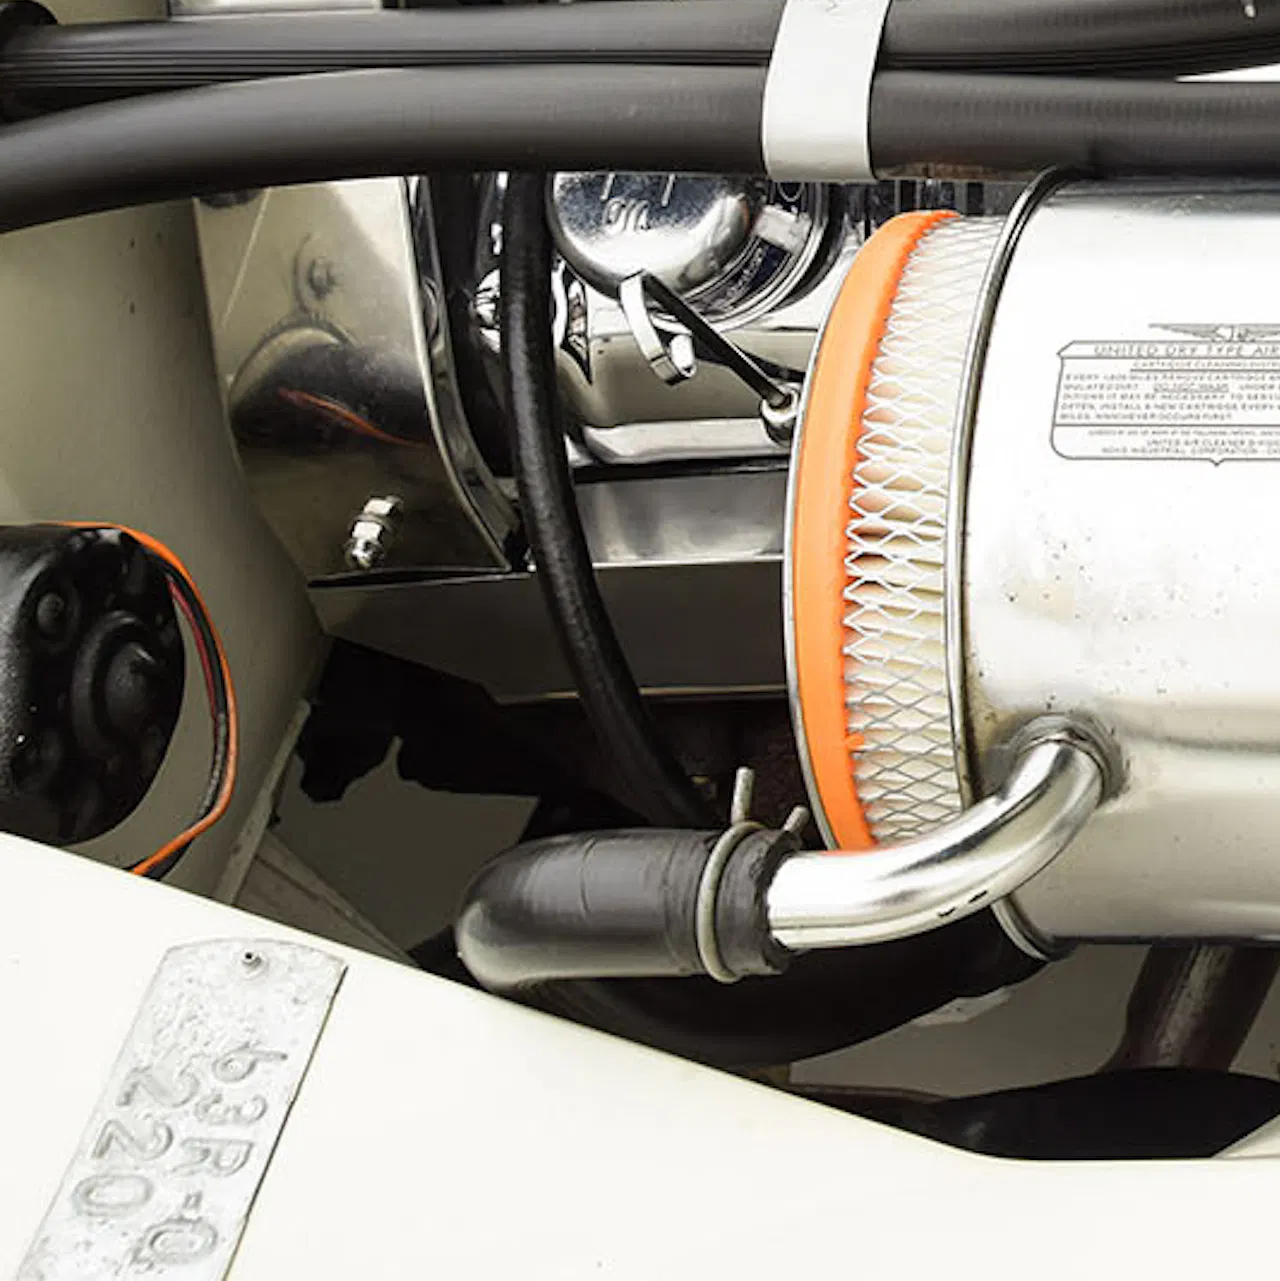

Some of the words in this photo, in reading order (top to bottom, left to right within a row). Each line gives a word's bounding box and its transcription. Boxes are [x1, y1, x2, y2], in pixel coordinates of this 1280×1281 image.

[1094, 344, 1159, 357] UNITED
[1166, 344, 1198, 357] DRY
[1207, 344, 1243, 357] TYPE
[1253, 344, 1279, 357] AIR
